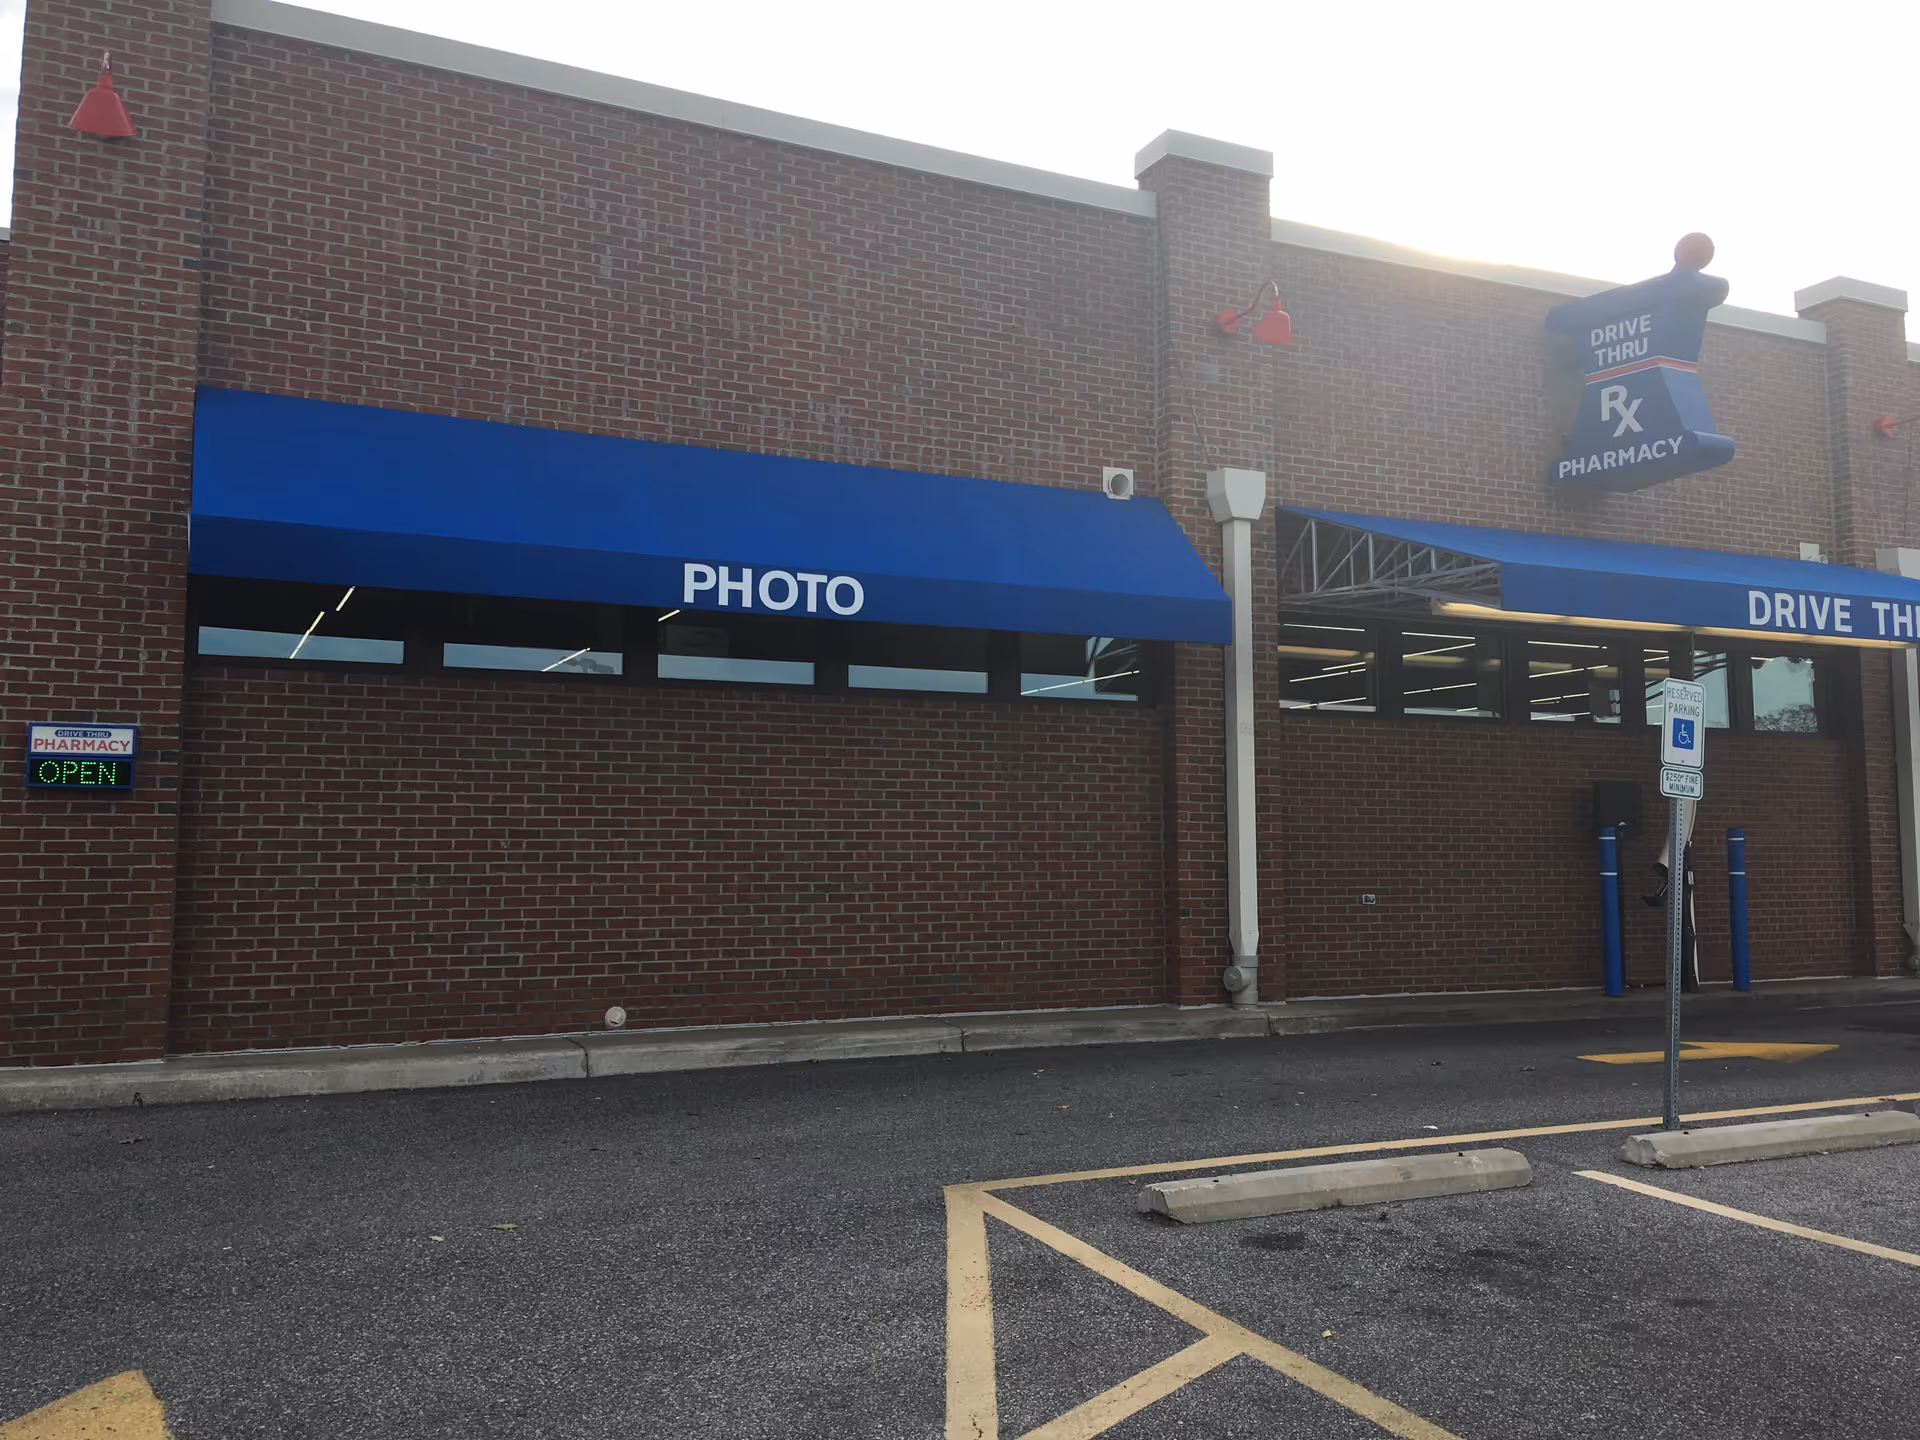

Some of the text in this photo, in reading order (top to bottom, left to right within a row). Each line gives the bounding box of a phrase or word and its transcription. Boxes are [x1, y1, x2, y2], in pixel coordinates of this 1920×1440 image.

[1591, 314, 1652, 347] DRIVE
[1594, 337, 1648, 366] THRU
[1559, 435, 1683, 479] PHARMACY
[683, 562, 865, 616] PHOTO
[1748, 590, 1920, 639] DRIVE TH
[1667, 686, 1702, 703] RESERVED
[1668, 702, 1700, 717] PARKING
[57, 730, 84, 738] DRIVE
[33, 738, 130, 752] PHARMACY
[38, 760, 116, 785] OPEN
[1685, 774, 1699, 785] FINE
[1669, 782, 1695, 794] MINIMUM
